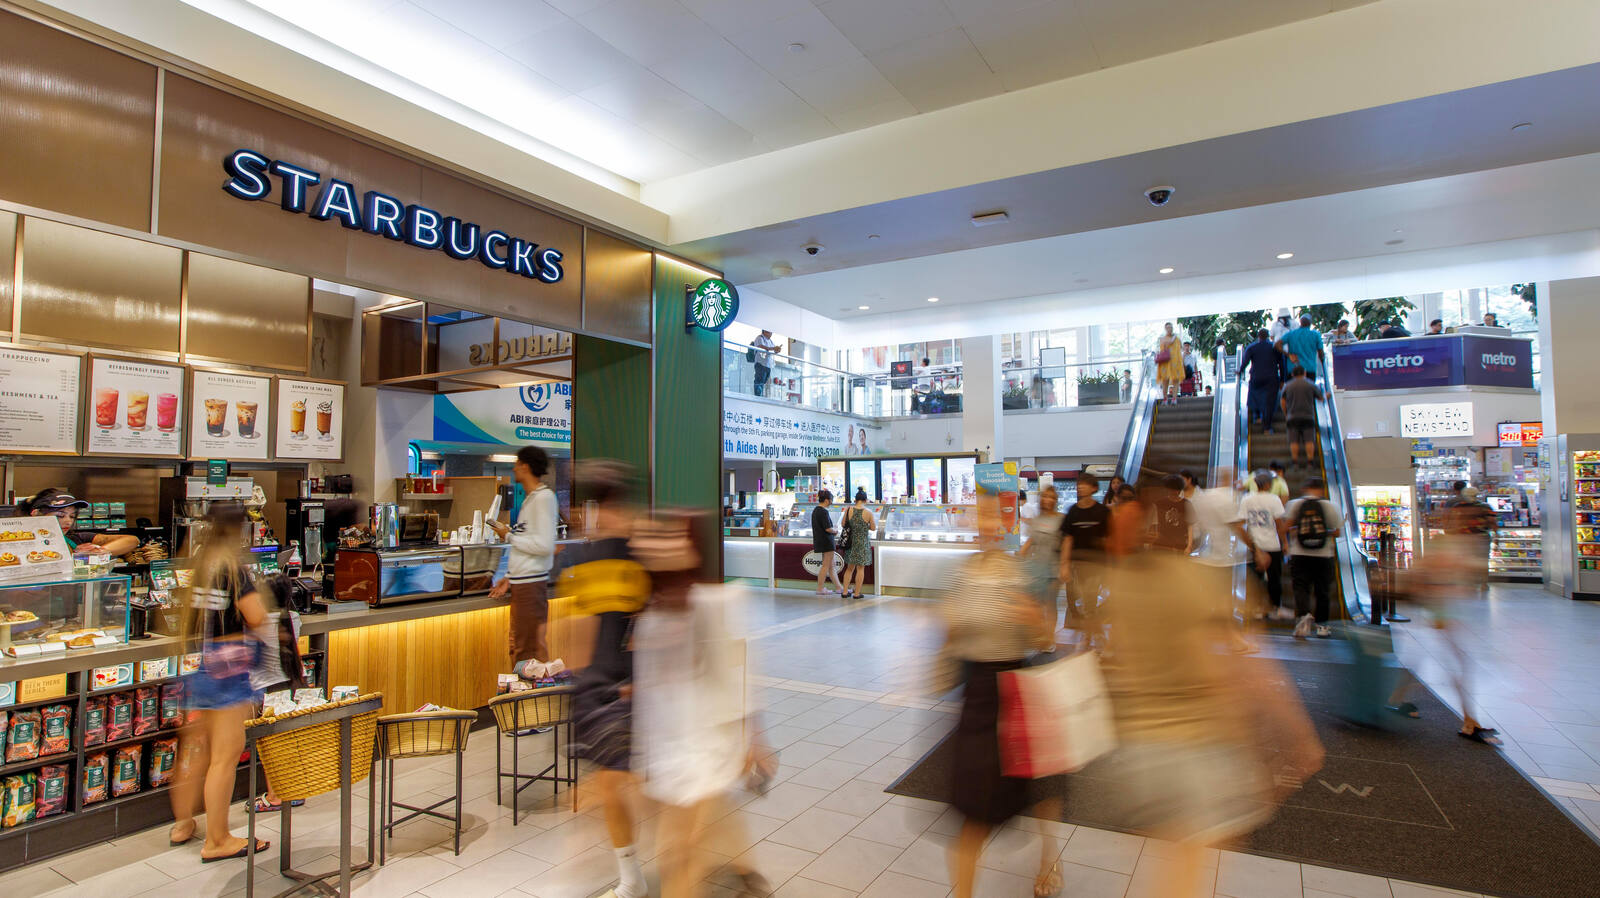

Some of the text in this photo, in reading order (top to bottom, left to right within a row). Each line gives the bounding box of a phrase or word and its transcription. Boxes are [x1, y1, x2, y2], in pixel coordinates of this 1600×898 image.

[222, 149, 564, 284] STARBUCKS
[1364, 354, 1424, 369] metro
[1481, 351, 1516, 366] metro
[554, 383, 572, 396] ABI
[723, 410, 753, 425] 中心五楼
[1410, 407, 1462, 420] SKEW
[519, 429, 529, 438] The
[530, 429, 541, 439] best
[541, 431, 557, 439] choice
[1500, 432, 1521, 442] 500
[725, 439, 734, 453] th
[736, 440, 758, 455] Aides
[759, 442, 780, 459] Apply
[781, 444, 799, 457] Now:
